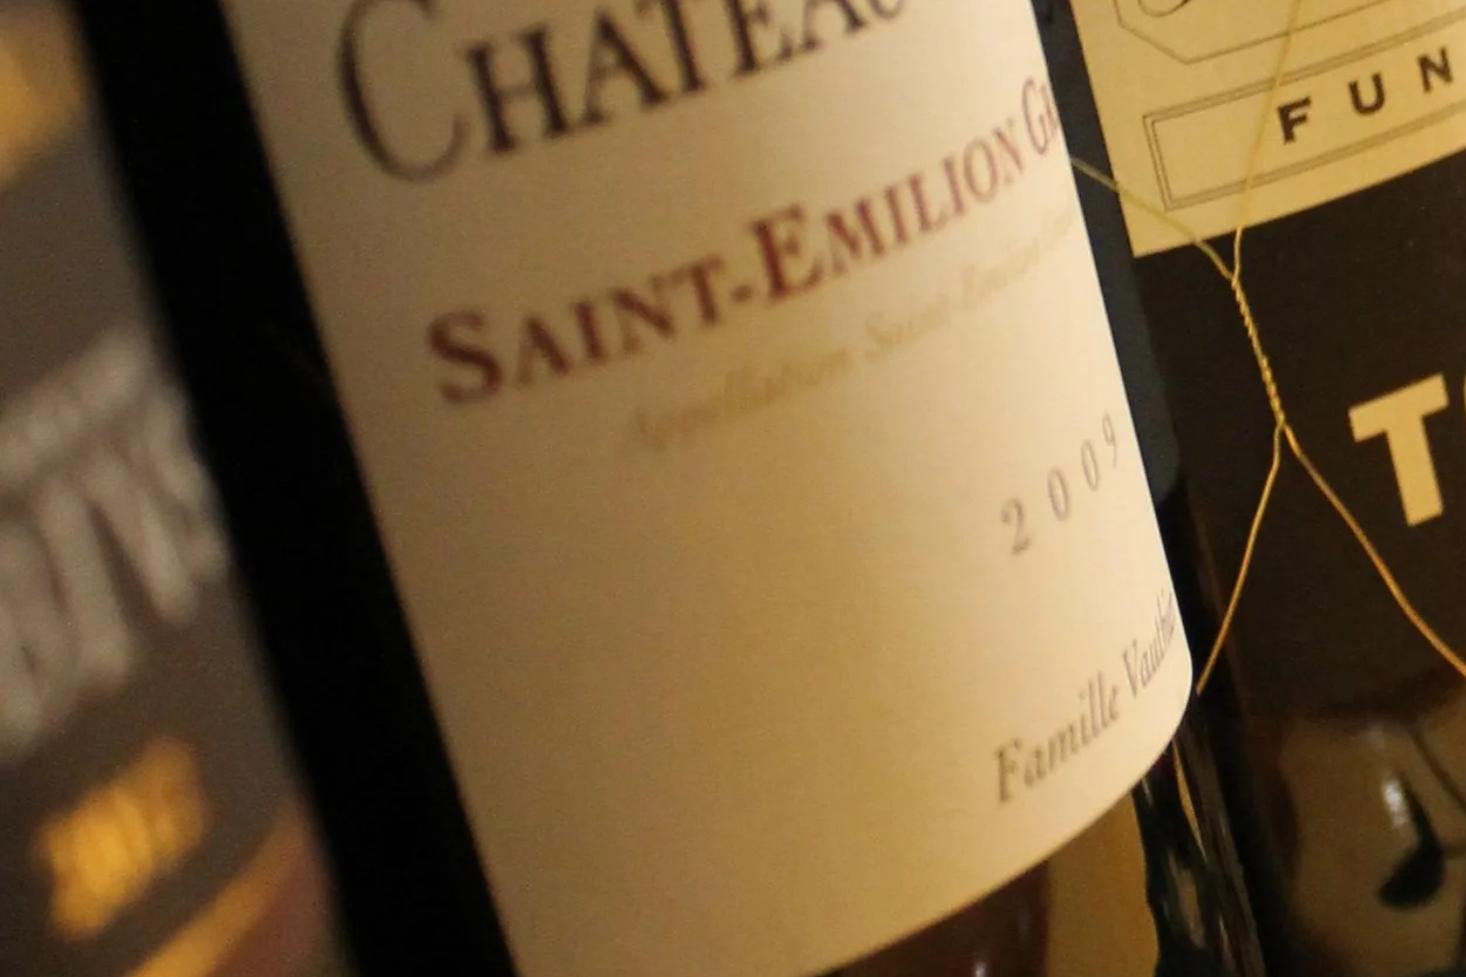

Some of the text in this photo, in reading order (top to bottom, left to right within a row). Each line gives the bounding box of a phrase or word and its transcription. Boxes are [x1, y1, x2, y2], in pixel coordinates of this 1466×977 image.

[427, 117, 1025, 406] SAINT-EMILION
[1000, 413, 1119, 556] 2009
[994, 669, 1120, 804] Famille
